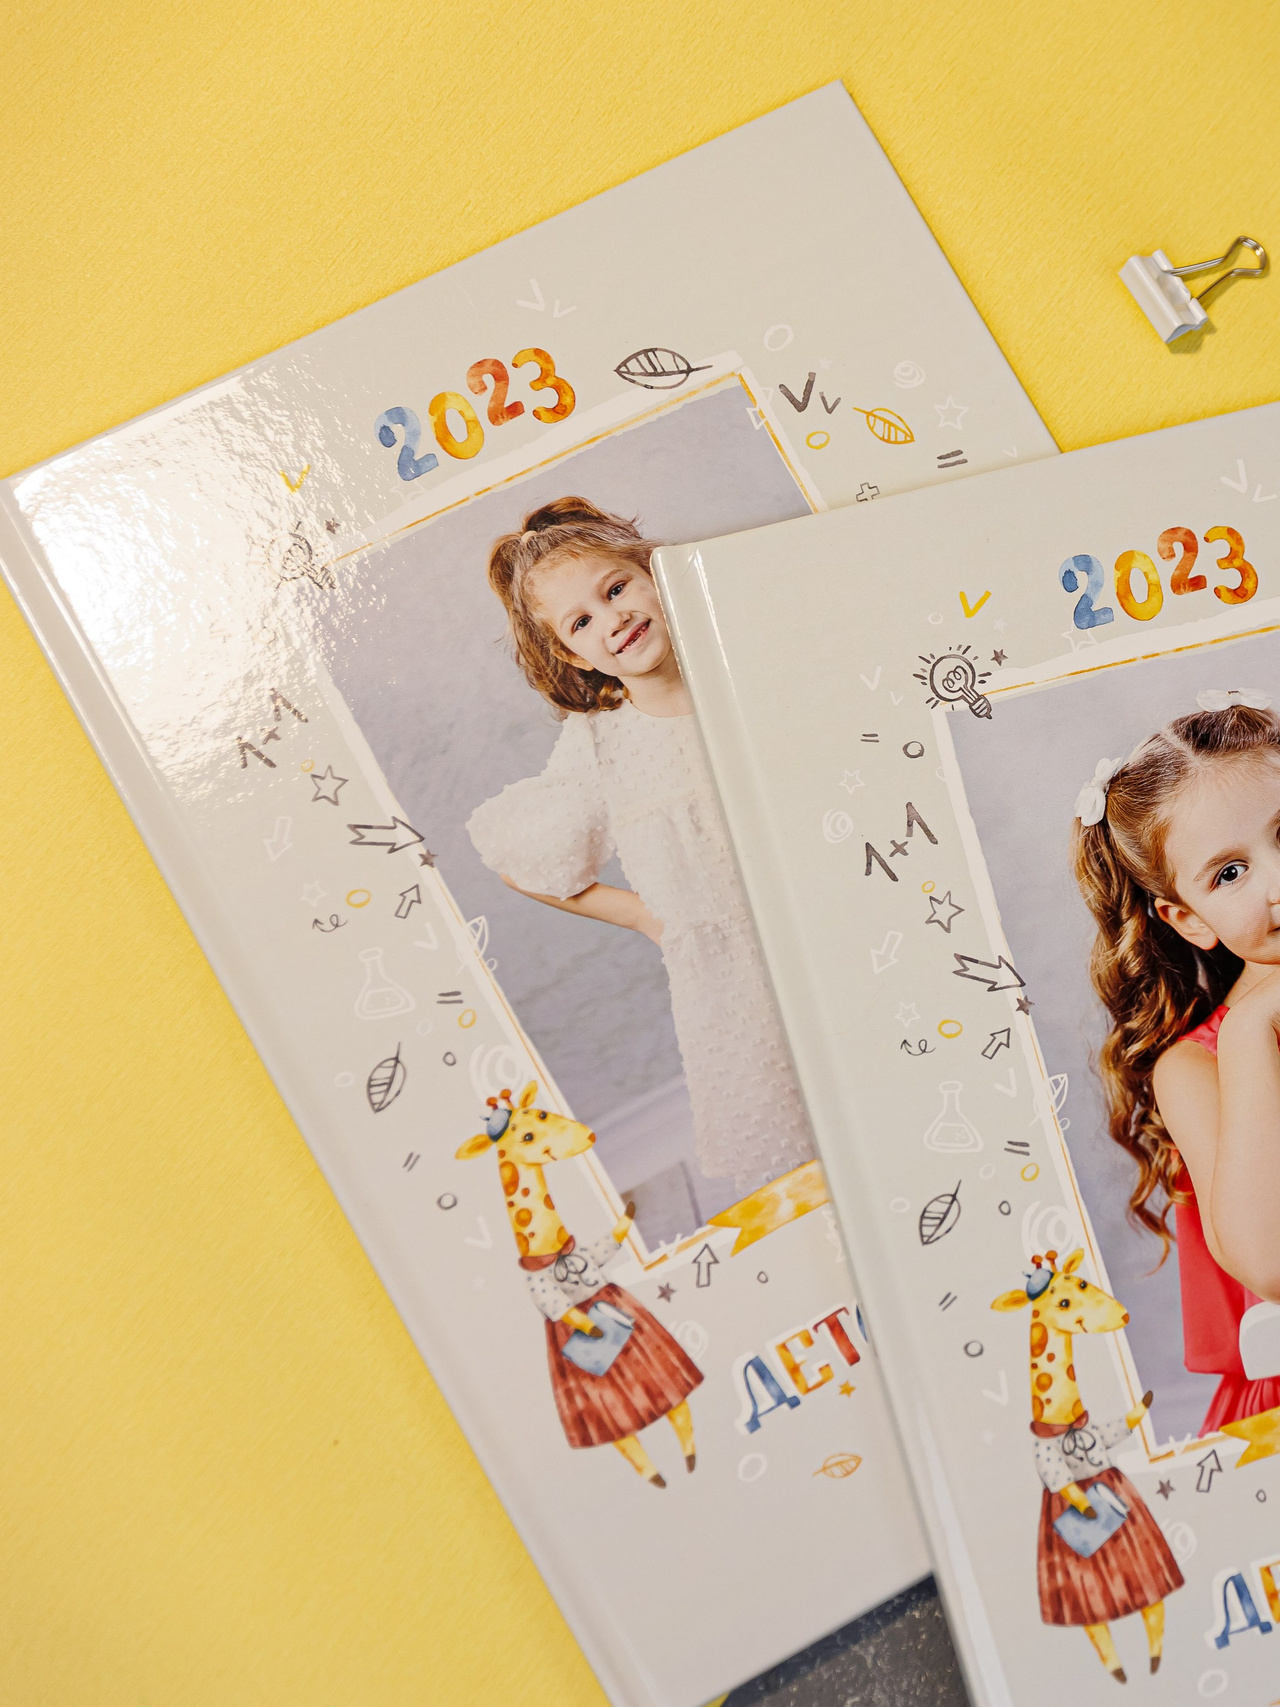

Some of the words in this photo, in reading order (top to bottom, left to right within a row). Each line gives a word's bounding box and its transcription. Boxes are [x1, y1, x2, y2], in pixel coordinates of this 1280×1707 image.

[374, 347, 576, 482] 2023
[1058, 525, 1259, 630] 2023
[744, 1305, 868, 1434] ДЕТ
